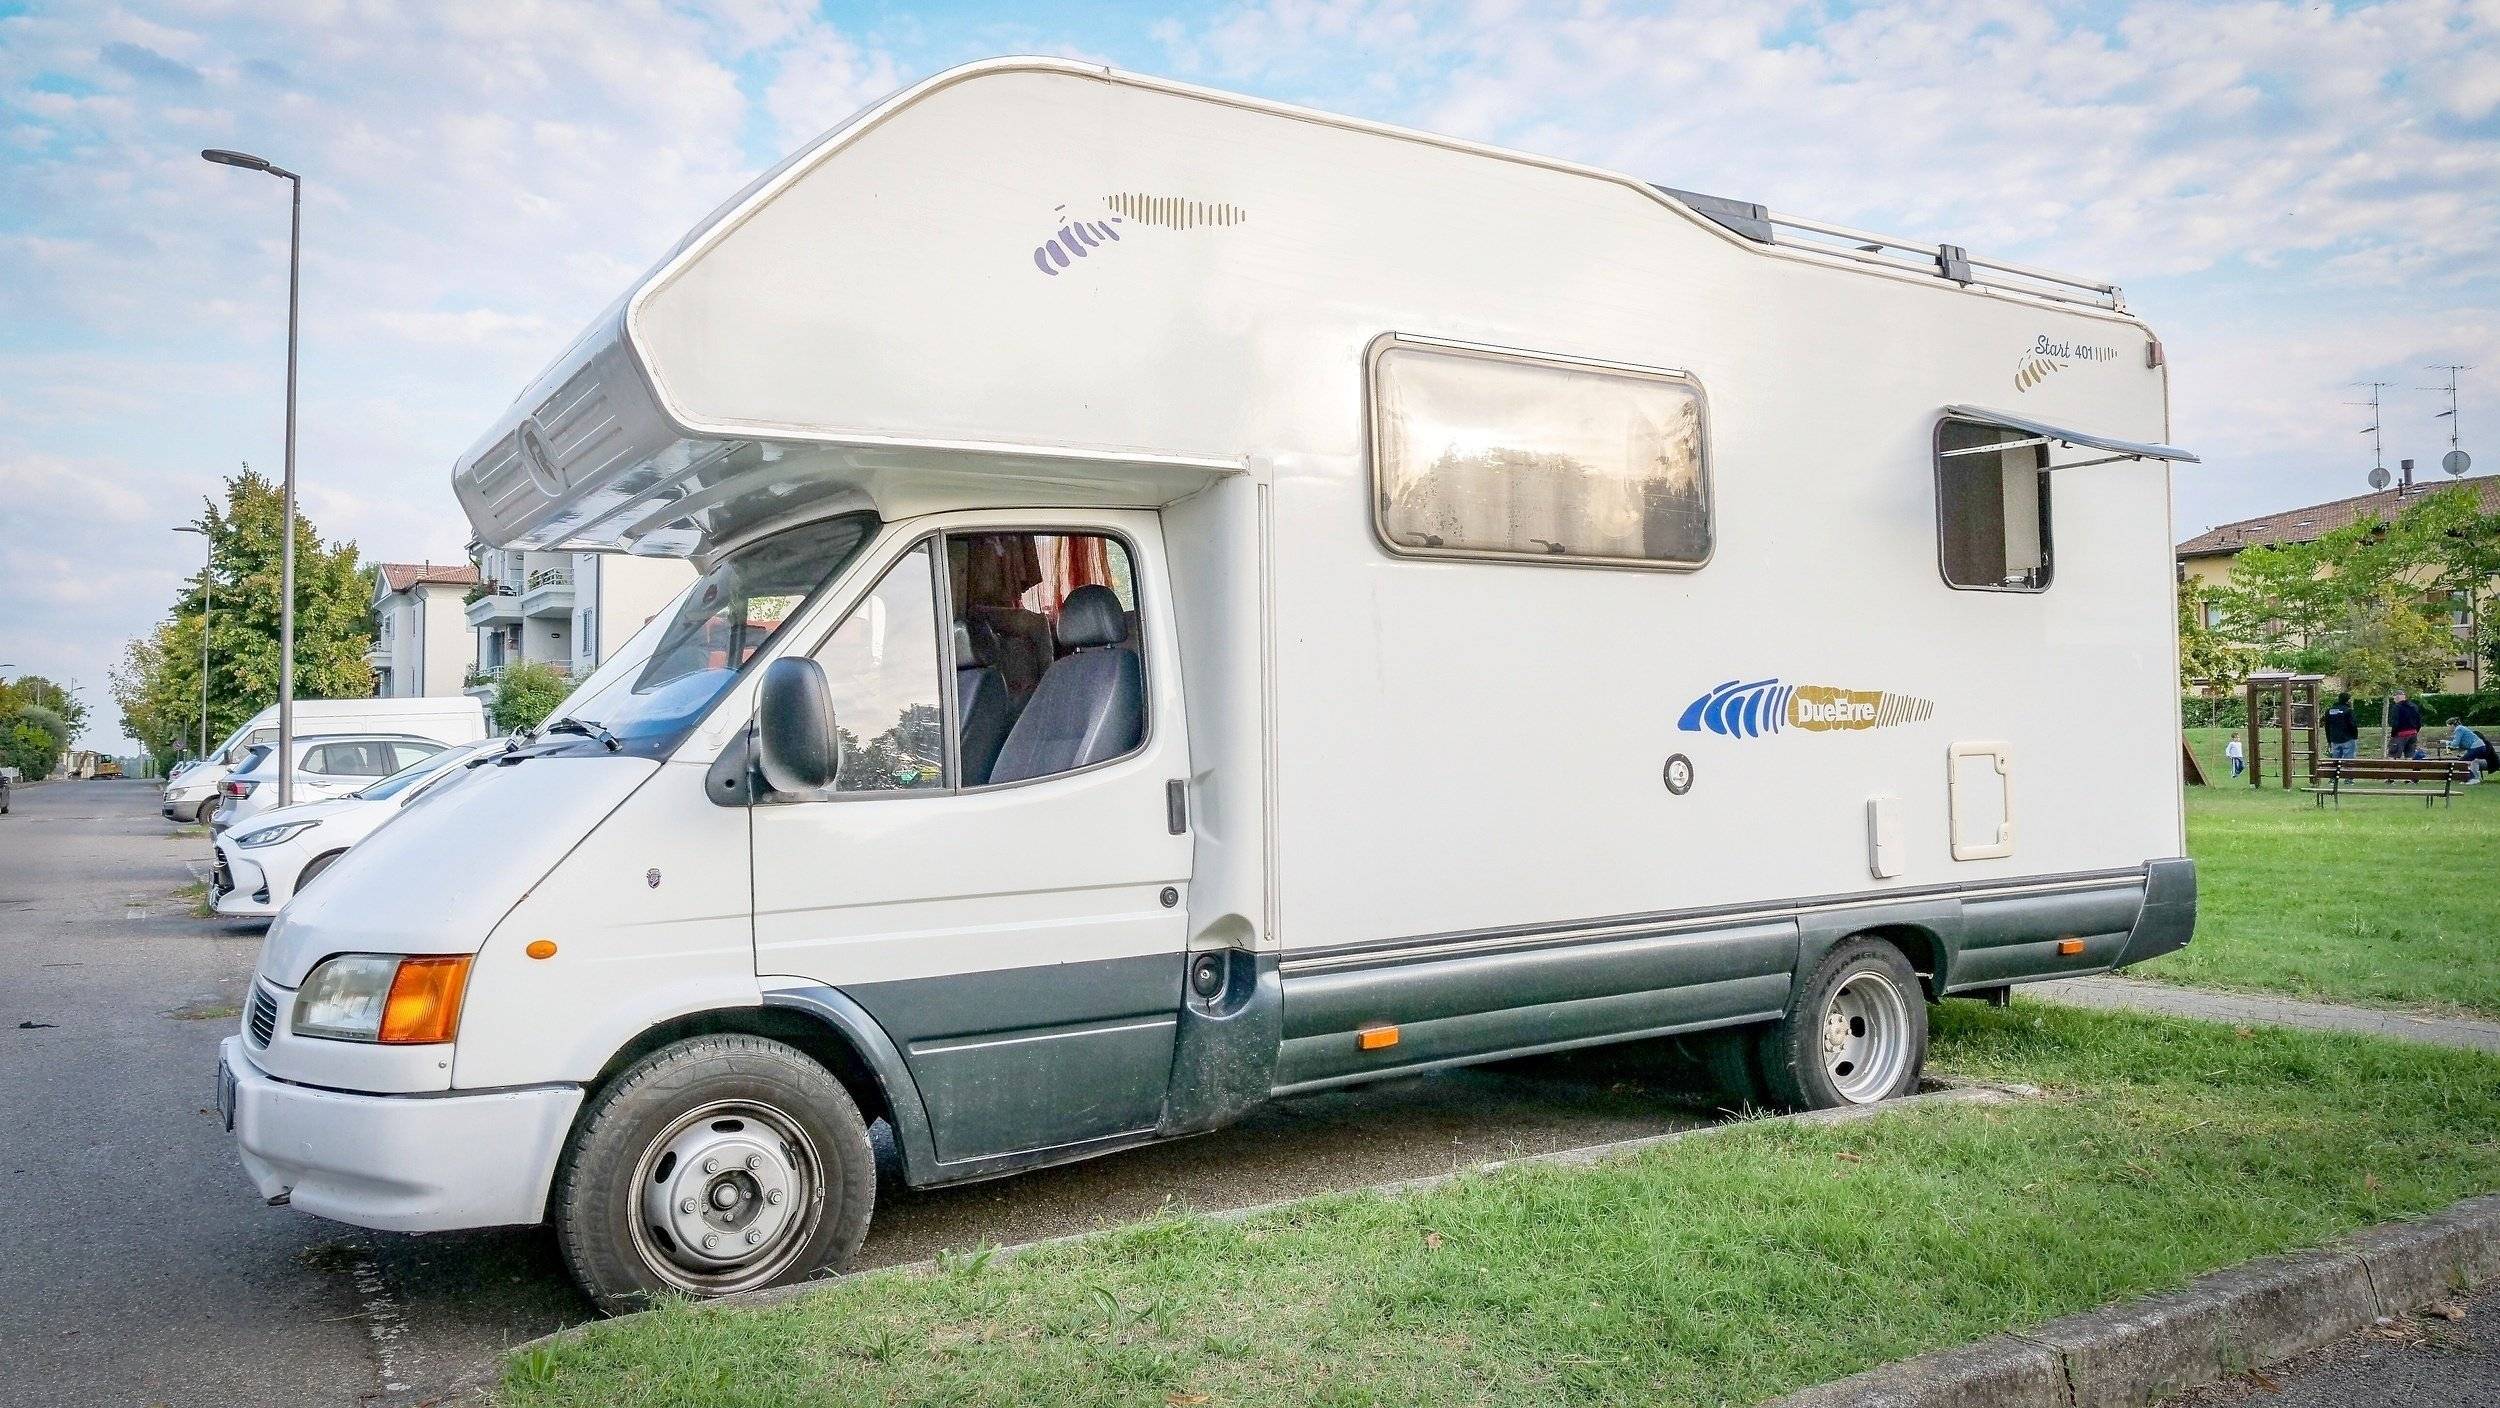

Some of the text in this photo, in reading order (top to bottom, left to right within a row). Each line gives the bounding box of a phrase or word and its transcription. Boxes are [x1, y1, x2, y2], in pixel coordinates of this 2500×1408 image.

[2035, 334, 2093, 360] Start 401
[1798, 699, 1877, 722] DueErre
